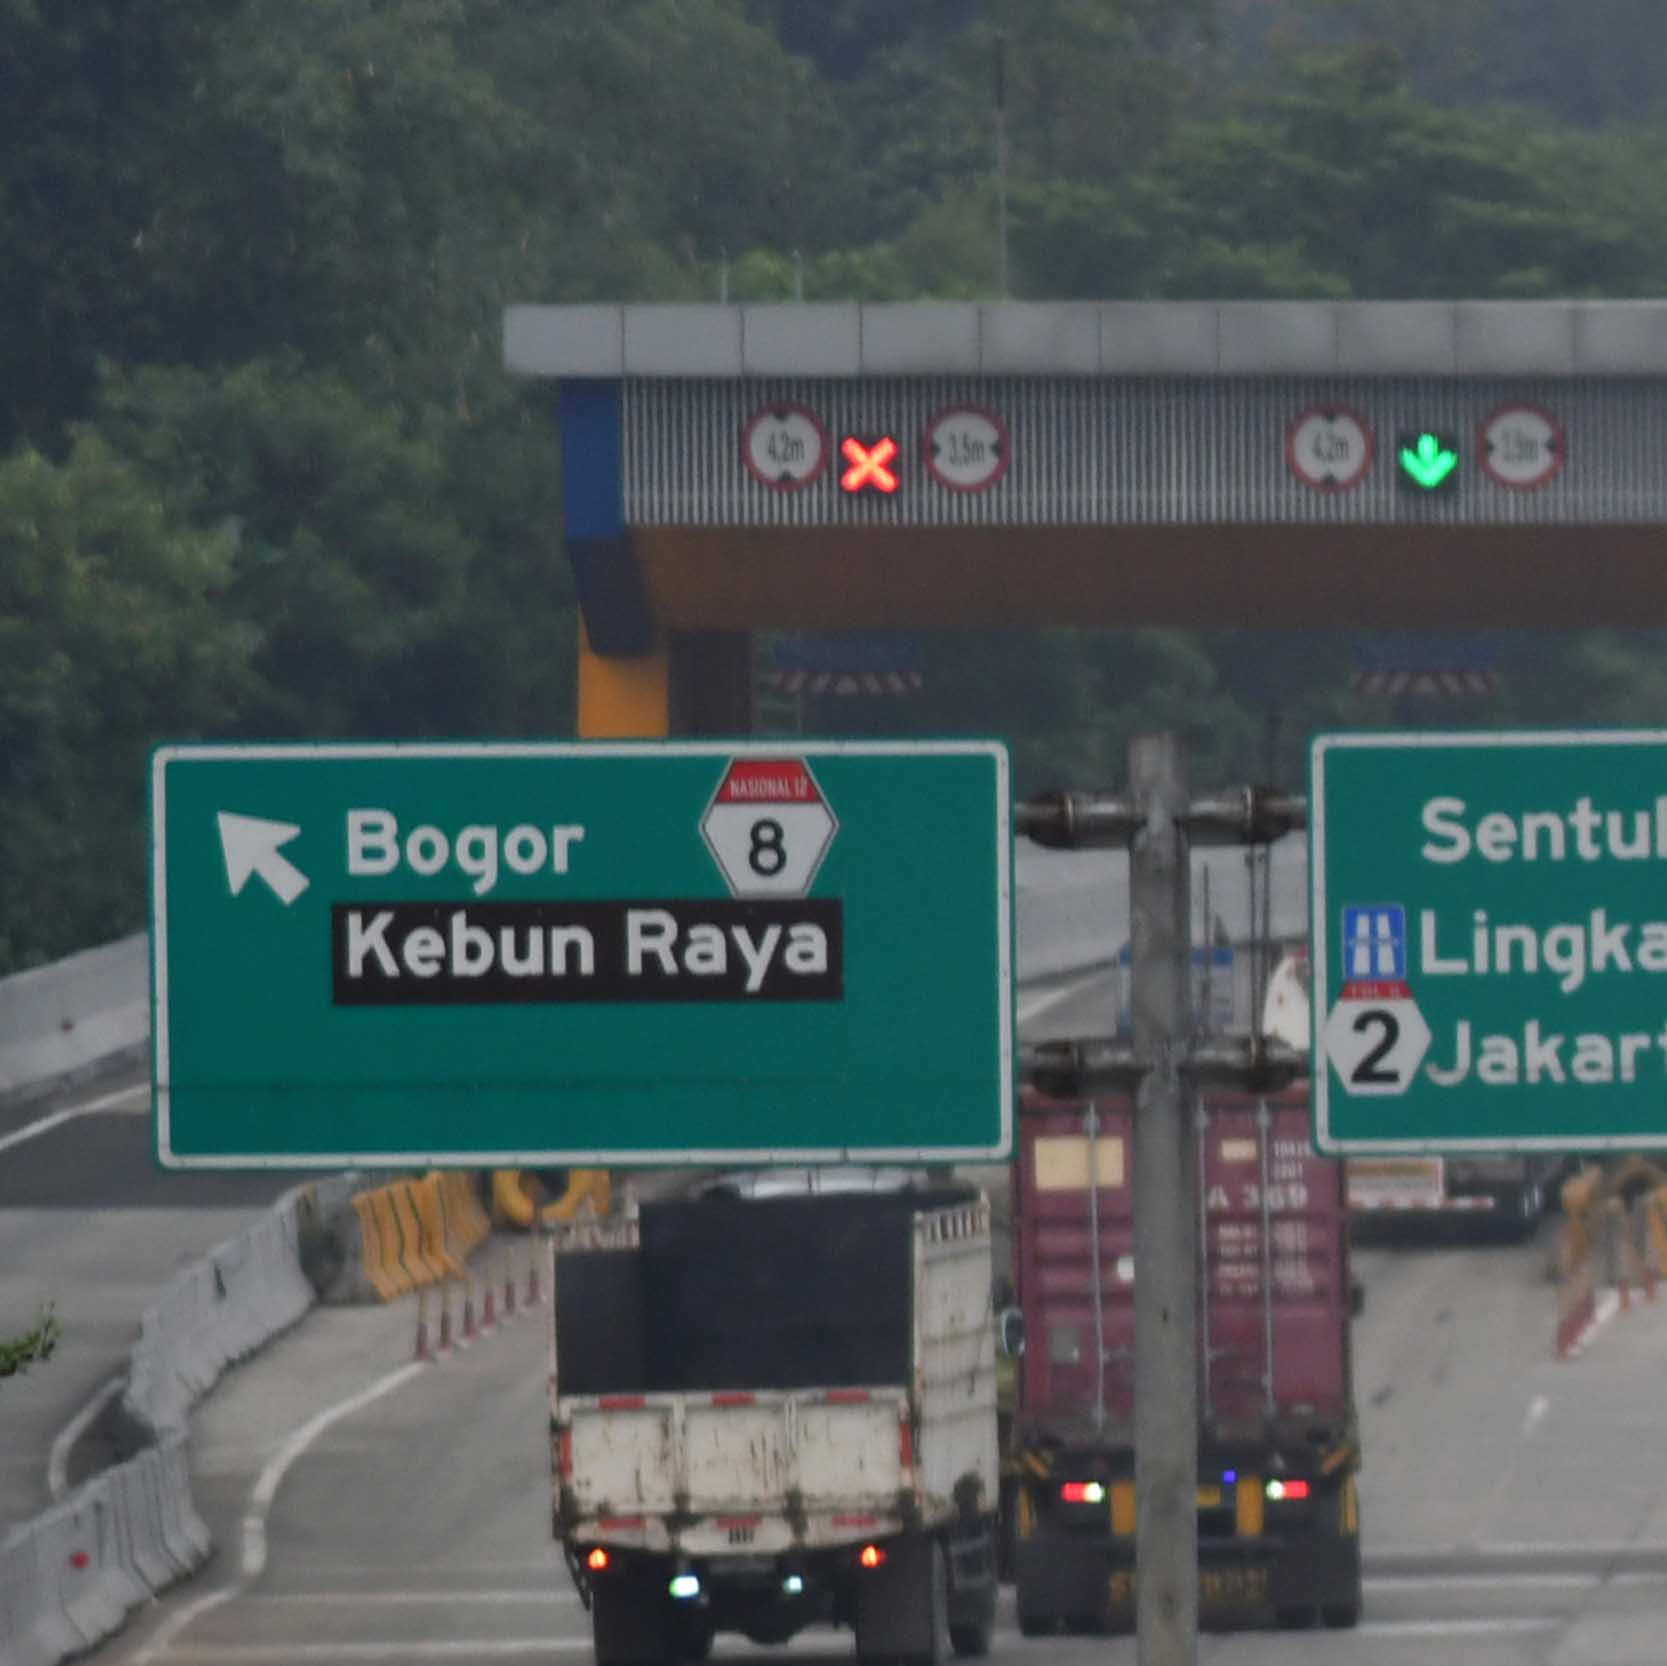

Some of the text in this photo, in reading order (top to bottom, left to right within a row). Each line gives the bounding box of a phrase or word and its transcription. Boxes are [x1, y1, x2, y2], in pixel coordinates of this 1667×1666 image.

[730, 776, 790, 798] NASIONAL
[346, 807, 586, 897] Bogor
[749, 817, 787, 877] 8
[346, 908, 829, 992] Kebun Raya
[1351, 1008, 1400, 1084] 2
